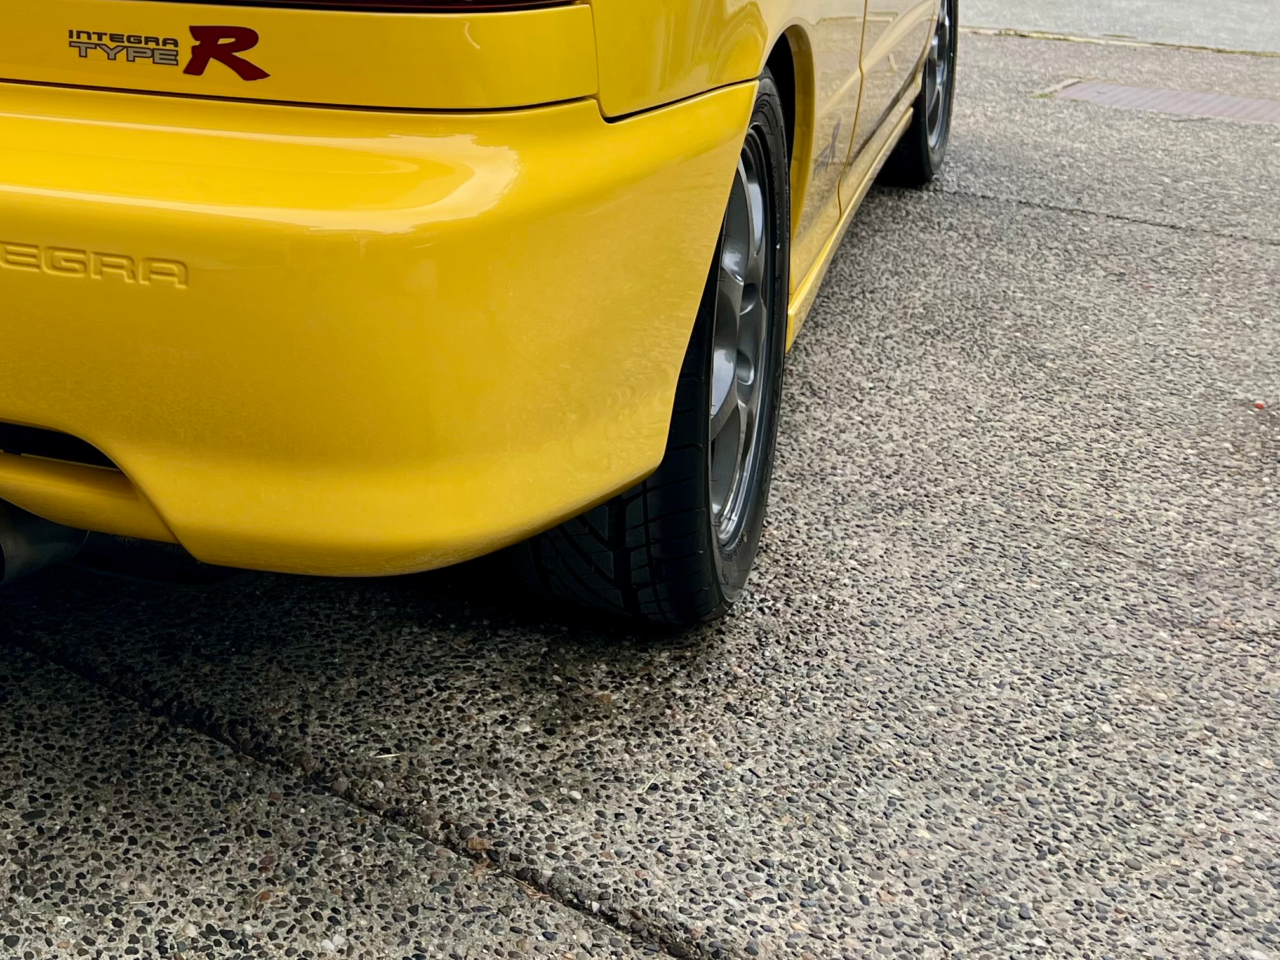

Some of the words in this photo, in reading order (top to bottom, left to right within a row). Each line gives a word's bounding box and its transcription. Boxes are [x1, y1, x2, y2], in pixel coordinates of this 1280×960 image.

[68, 29, 179, 48] INTEGRA
[68, 40, 179, 66] TYPE
[182, 25, 271, 81] R
